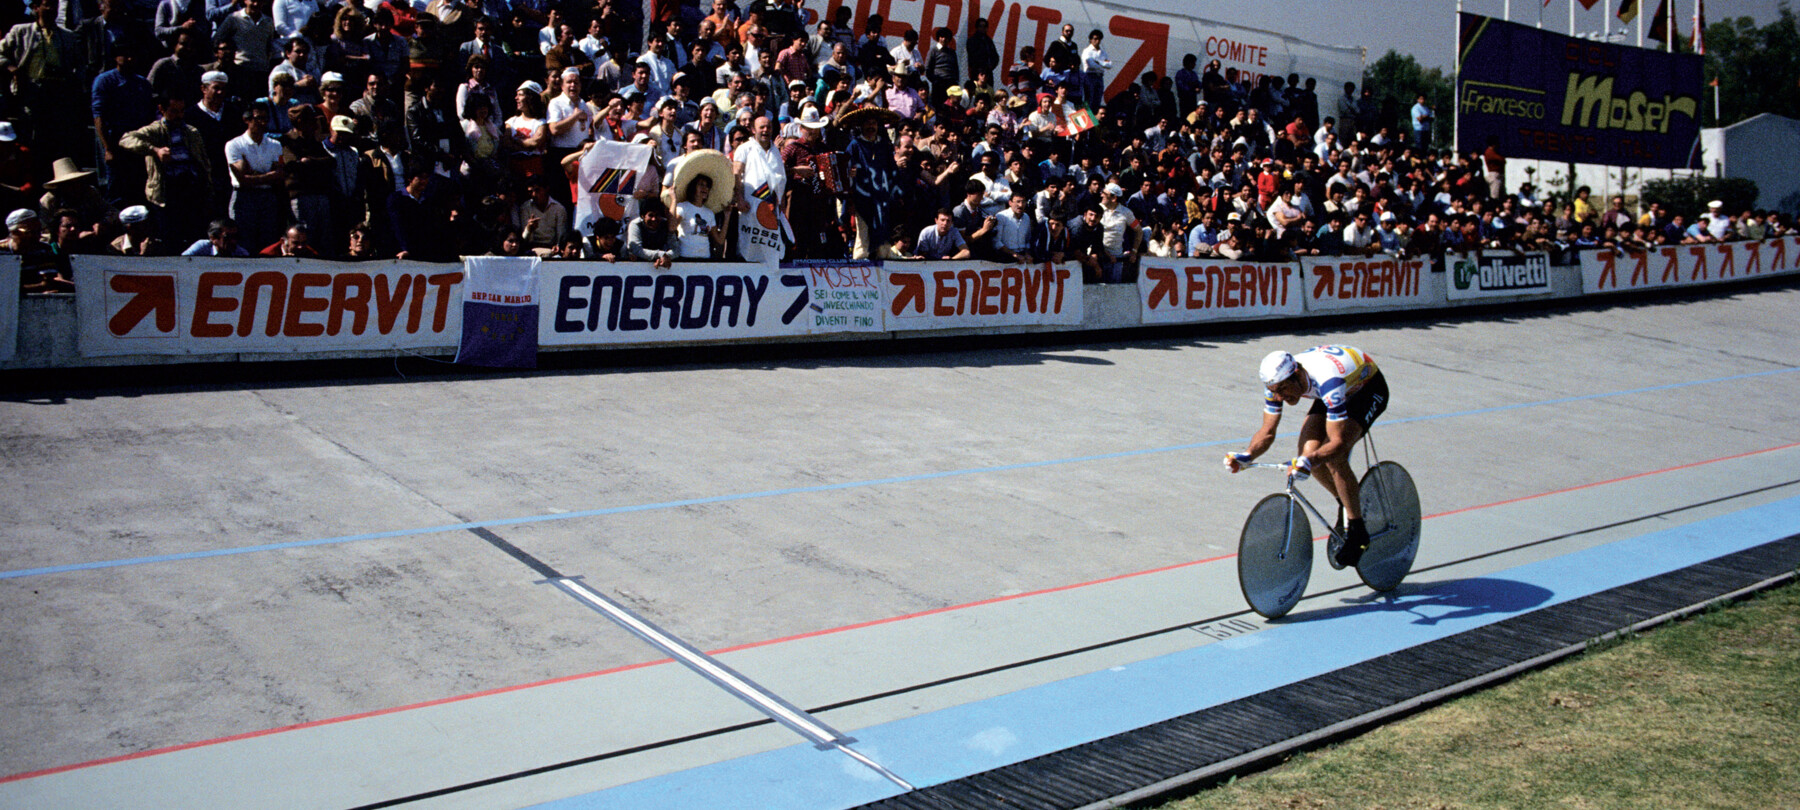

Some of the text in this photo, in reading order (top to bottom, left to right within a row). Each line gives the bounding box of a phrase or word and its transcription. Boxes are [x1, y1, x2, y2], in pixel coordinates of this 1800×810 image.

[1206, 36, 1268, 67] COMITE
[1565, 42, 1622, 68] CICLI
[1519, 128, 1598, 156] TRENTO
[1617, 138, 1663, 160] ITALY
[741, 224, 779, 241] MOSE
[809, 266, 877, 289] MOSER
[1338, 260, 1424, 299] ENERVIT
[1480, 257, 1546, 287] olivetti
[814, 290, 828, 300] SEI
[831, 290, 850, 299] COME
[861, 290, 879, 300] VINO
[933, 268, 1071, 316] ENERVIT
[1185, 264, 1289, 309] ENERVIT
[191, 271, 463, 338] ENERVIT
[554, 275, 769, 332] ENERDAY
[823, 301, 874, 311] INVECCHIANDO
[815, 315, 874, 327] DIVENTI FINO
